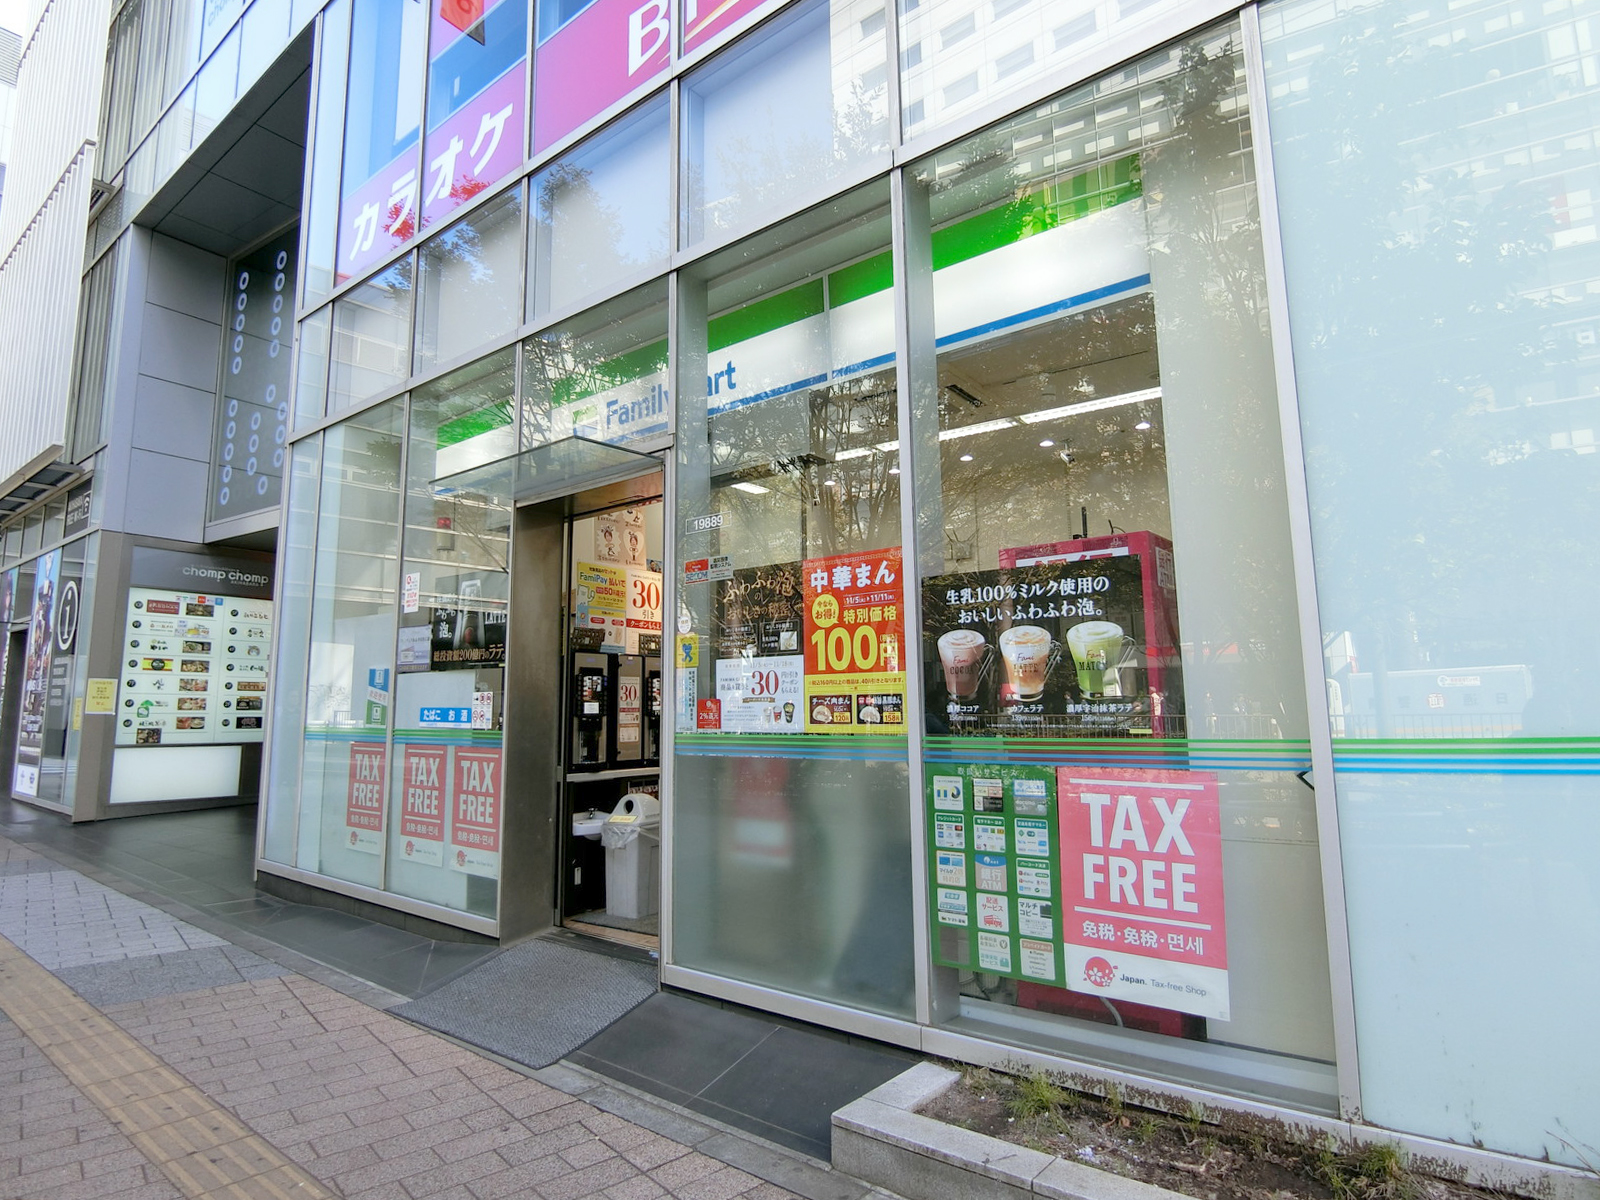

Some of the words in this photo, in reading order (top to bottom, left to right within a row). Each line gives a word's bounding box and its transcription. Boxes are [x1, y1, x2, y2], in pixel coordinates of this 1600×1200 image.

[350, 103, 514, 261] カラオケ
[693, 515, 723, 530] 19889
[182, 565, 226, 582] chomp
[228, 570, 269, 586] chomp
[579, 571, 608, 584] FamiPay
[685, 571, 708, 582] SECOM
[810, 560, 895, 593] 中華まん
[633, 579, 661, 611] 30
[946, 576, 1110, 606] 生乳100%ミルク使用の
[815, 609, 836, 620] お得!
[844, 605, 897, 624] 特別価格
[957, 597, 1103, 624] おいしいふわふわ泡。
[953, 655, 970, 665] Fami
[1016, 652, 1035, 662] Fami
[1013, 663, 1039, 675] LATTE
[751, 670, 779, 696] 30
[620, 685, 637, 701] 30
[423, 709, 441, 721] たばこ
[946, 703, 979, 713] 濃厚ココア
[1011, 704, 1044, 713] カフェラテ
[1066, 703, 1133, 713] 濃厚宇治抹茶ラテ
[355, 753, 380, 782] TAX
[410, 756, 440, 787] TAX
[461, 760, 494, 793] TAX
[352, 782, 380, 808] FREE
[407, 787, 439, 816] FREE
[459, 793, 494, 824] FREE
[1080, 792, 1195, 856] TAX
[981, 881, 1003, 890] ATM
[1082, 853, 1199, 914] FREE
[982, 903, 1004, 912] サービス
[1019, 901, 1038, 909] マルチ
[1019, 909, 1038, 917] コピー
[1120, 973, 1148, 986] Japan.
[1151, 979, 1183, 993] Tax-free
[1185, 984, 1207, 998] Shop
